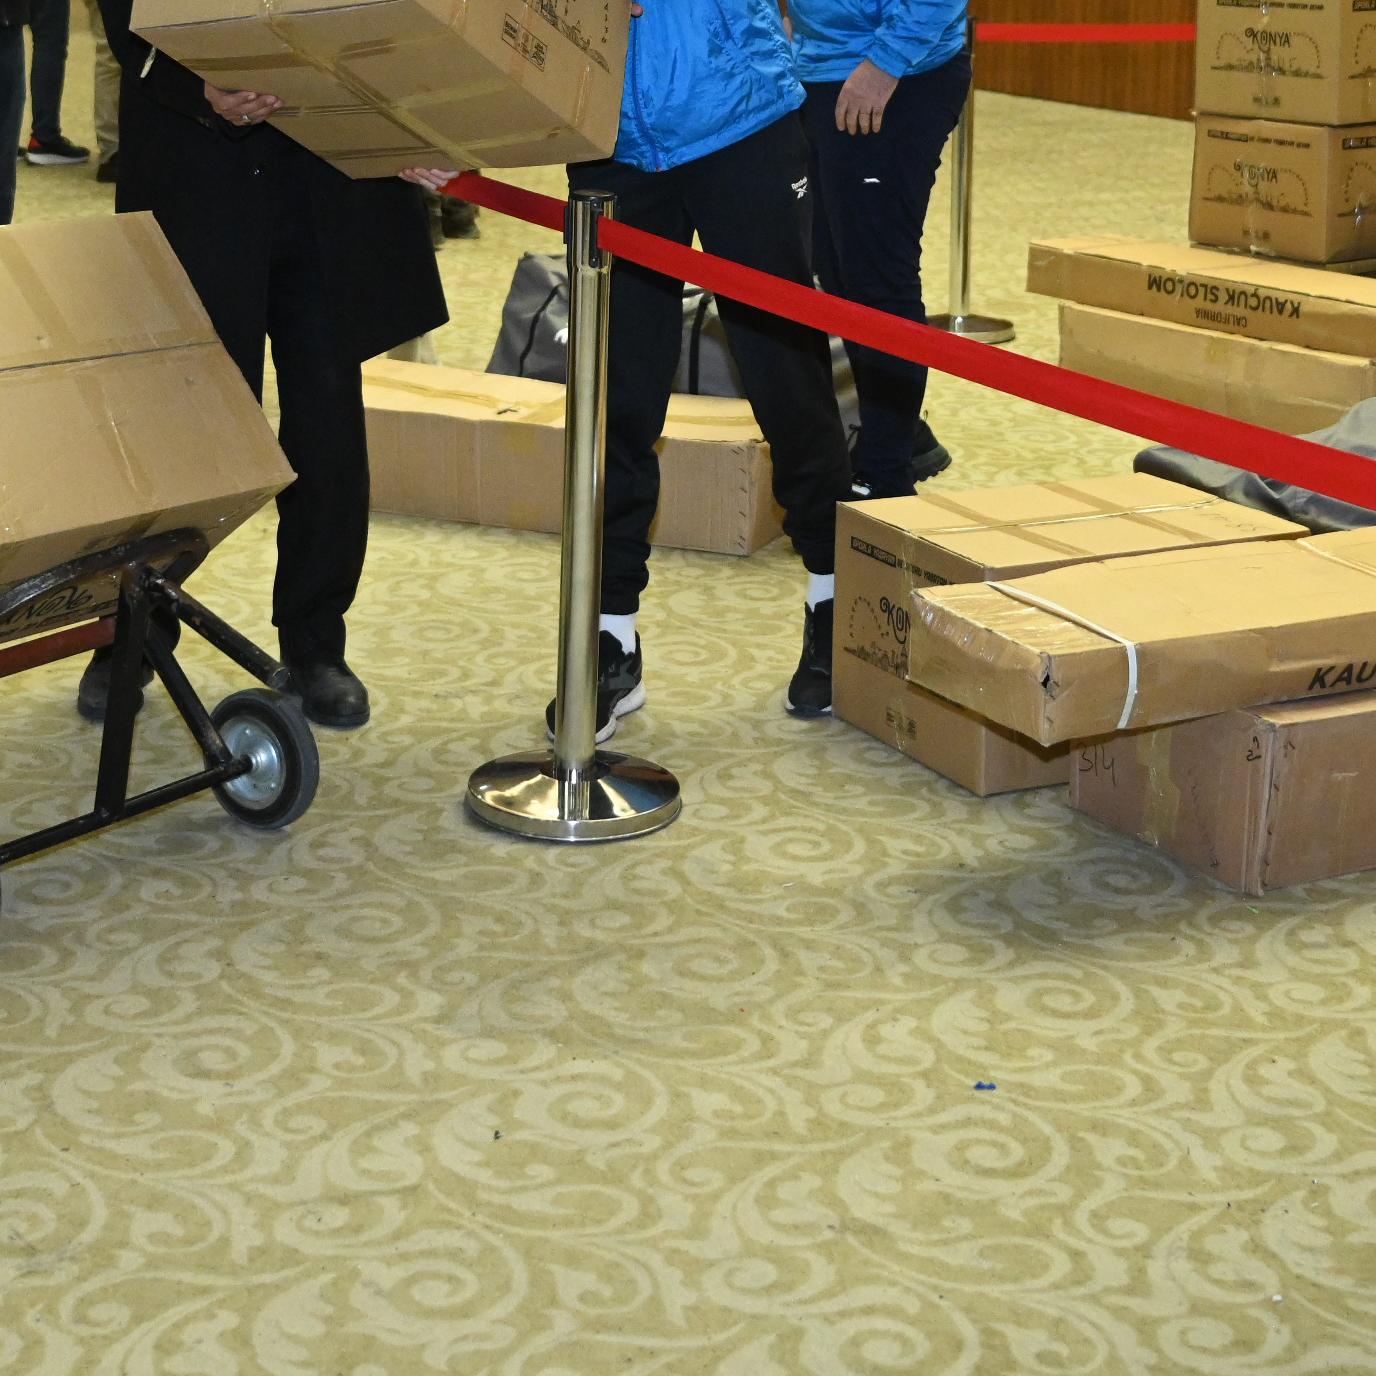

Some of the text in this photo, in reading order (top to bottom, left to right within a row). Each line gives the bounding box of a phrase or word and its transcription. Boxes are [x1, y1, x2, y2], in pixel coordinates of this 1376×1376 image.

[1245, 28, 1290, 53] KONYA
[1148, 274, 1301, 318] KAUÇUK SLOLOM
[1195, 307, 1247, 327] CALIFORNIA
[880, 596, 910, 644] KON
